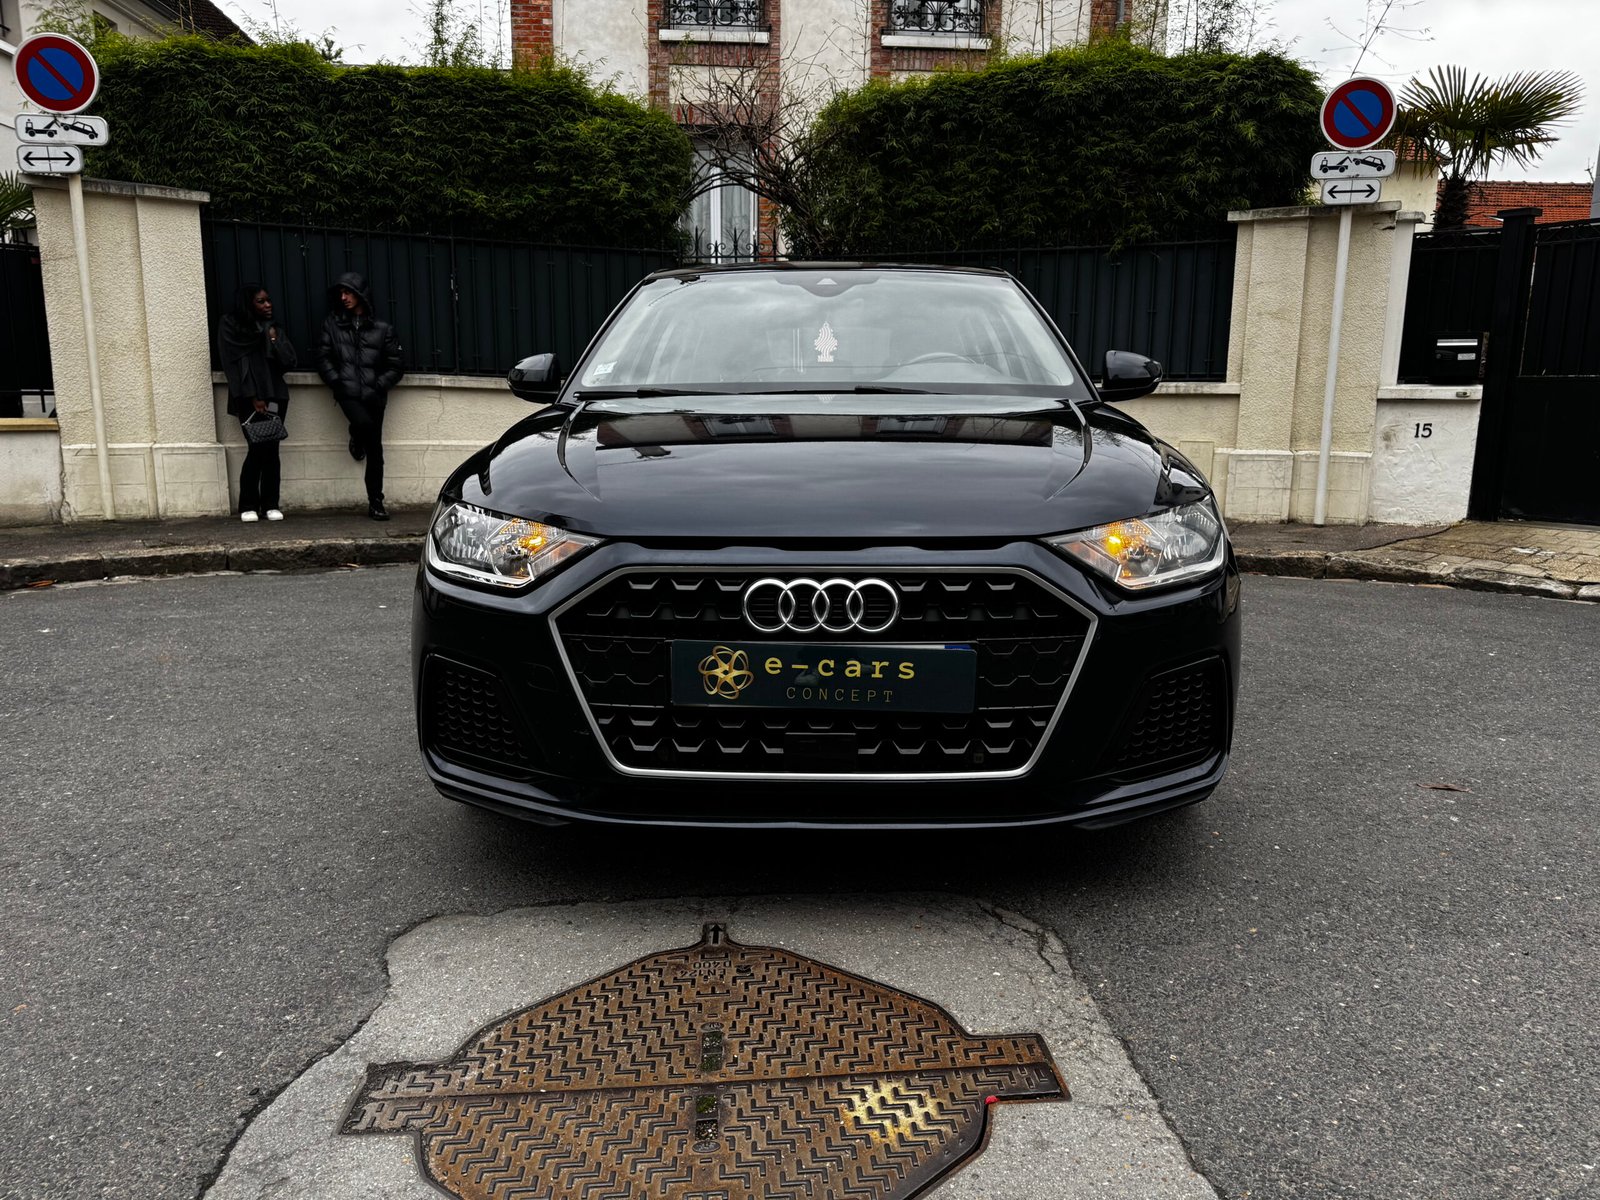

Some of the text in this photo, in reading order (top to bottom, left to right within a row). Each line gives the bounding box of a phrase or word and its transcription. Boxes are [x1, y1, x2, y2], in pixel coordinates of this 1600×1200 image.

[1414, 422, 1433, 439] 15
[764, 656, 916, 680] e-cars
[786, 686, 893, 703] CONCEPT
